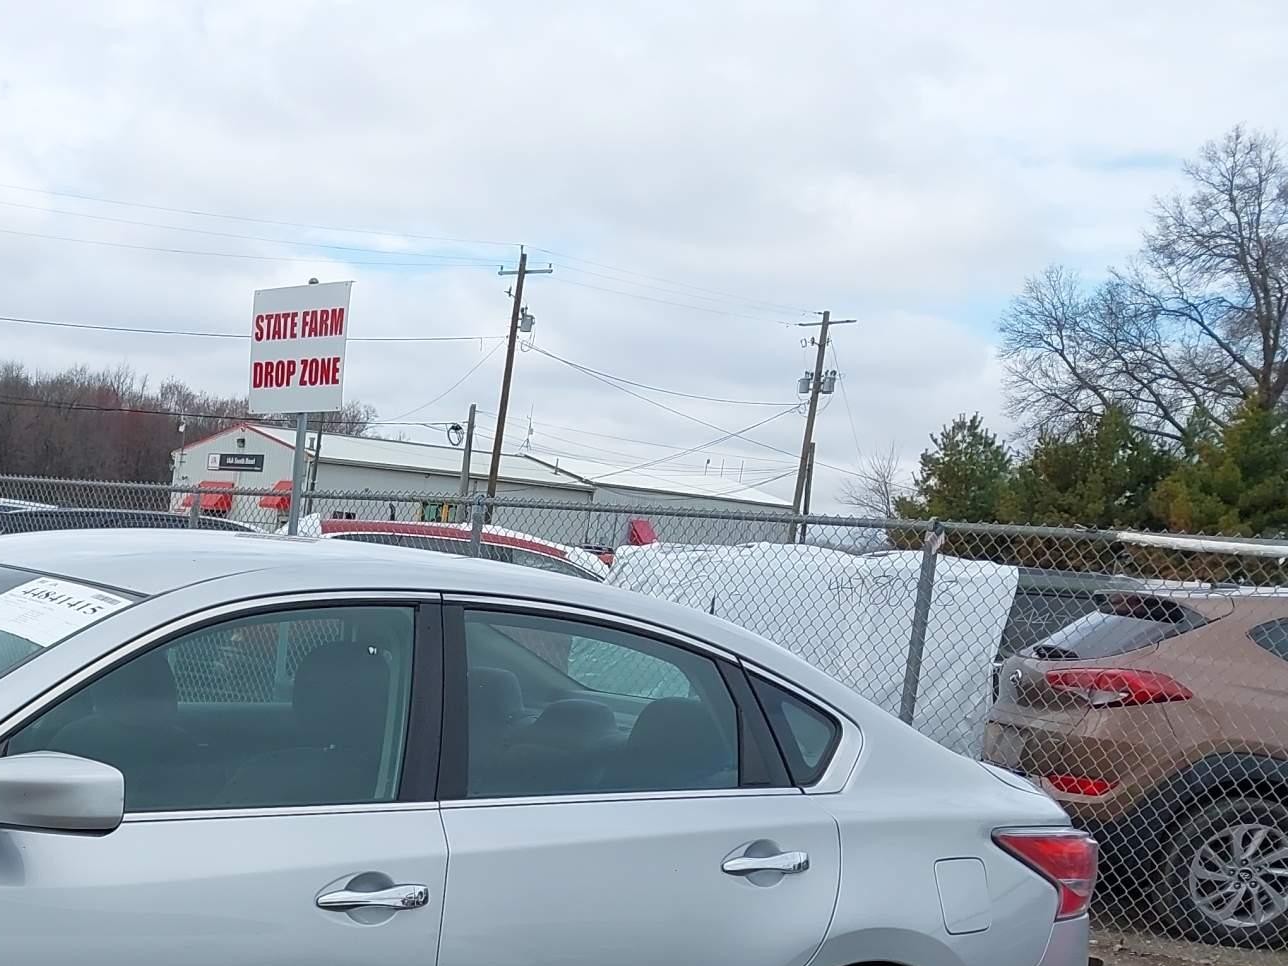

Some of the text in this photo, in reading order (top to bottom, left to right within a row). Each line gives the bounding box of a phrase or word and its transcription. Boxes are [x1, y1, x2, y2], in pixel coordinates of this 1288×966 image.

[254, 307, 345, 342] STATE FARM
[253, 356, 341, 388] DROP ZONE
[21, 587, 105, 615] 44841415
